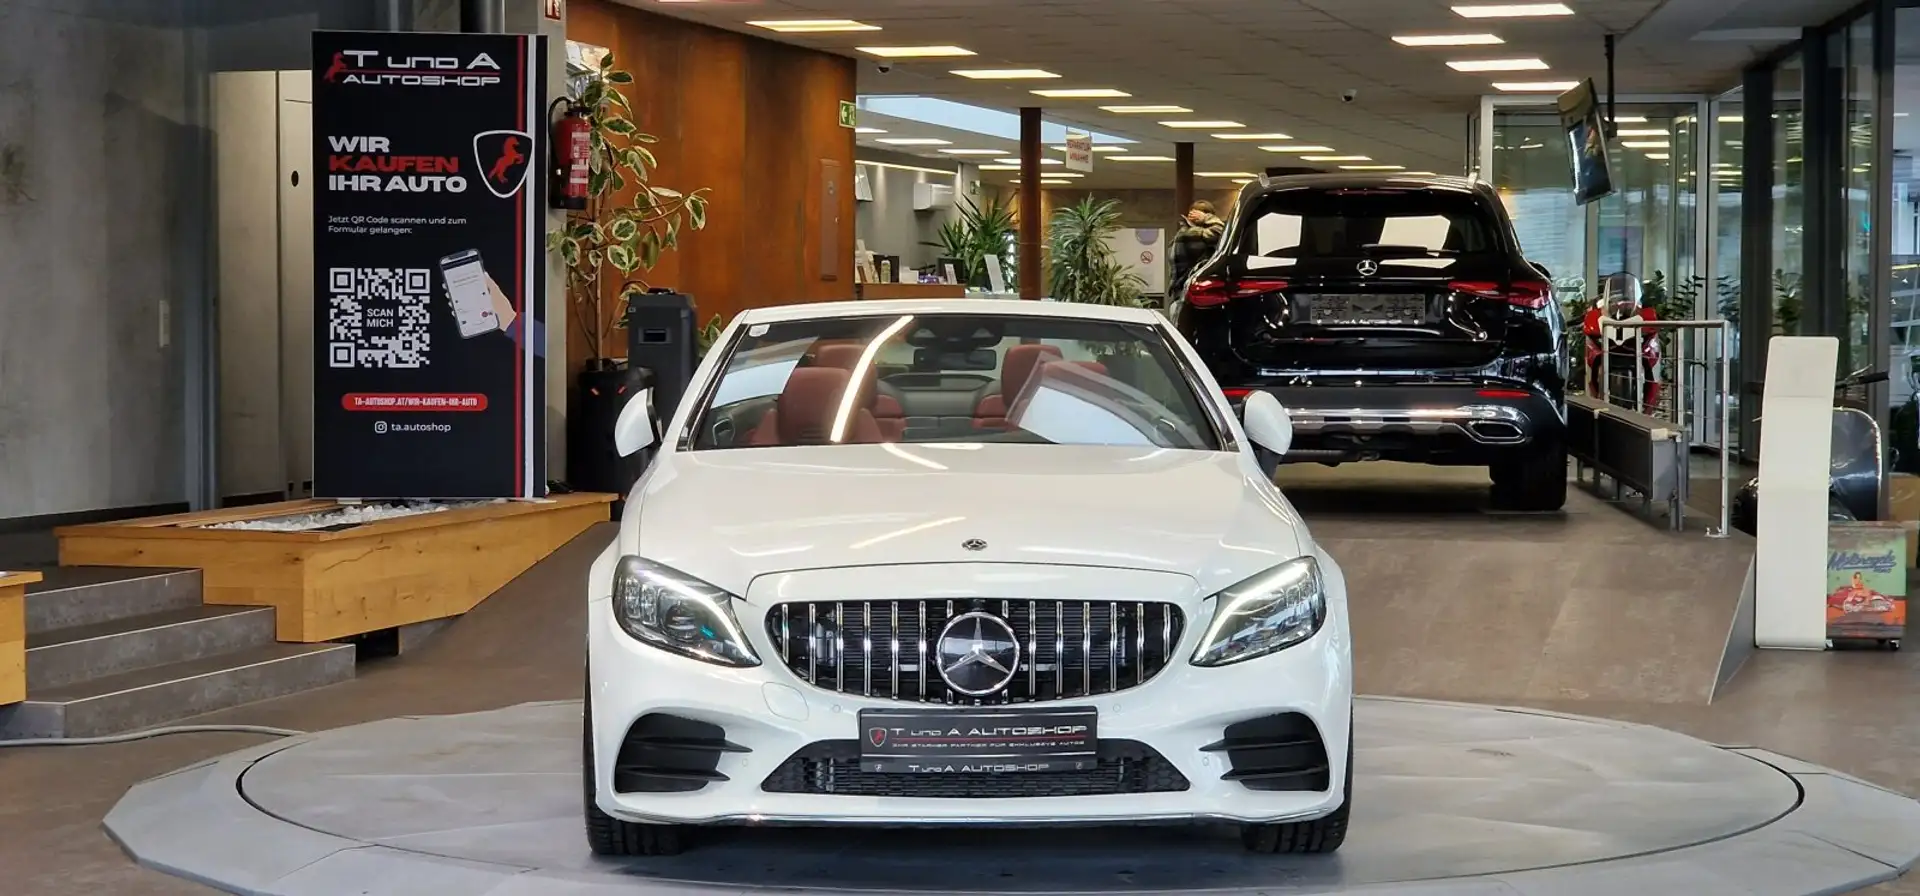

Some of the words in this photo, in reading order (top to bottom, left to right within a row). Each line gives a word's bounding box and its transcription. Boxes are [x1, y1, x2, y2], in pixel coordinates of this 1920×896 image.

[343, 50, 379, 67] T
[466, 53, 501, 70] A
[342, 74, 501, 87] AUTOSHOP
[328, 136, 390, 153] WIR
[329, 155, 459, 173] KAUFEN
[329, 175, 382, 191] IHR
[384, 176, 468, 193] AUTO
[328, 216, 350, 224] Jetzt
[351, 216, 365, 225] QR
[366, 216, 389, 224] Code
[390, 216, 427, 225] scannen
[429, 216, 446, 225] und
[447, 217, 467, 225] zum
[328, 225, 367, 233] Formular
[369, 226, 413, 235] gelangen:
[367, 308, 394, 317] SCAN
[367, 318, 394, 328] MICH
[391, 422, 452, 433] ta.autoshop
[890, 728, 905, 736] T
[947, 728, 962, 737] A
[967, 725, 1087, 736] AUTOSHOP
[943, 765, 955, 773] A
[961, 763, 1050, 773] AUTOSHOP
